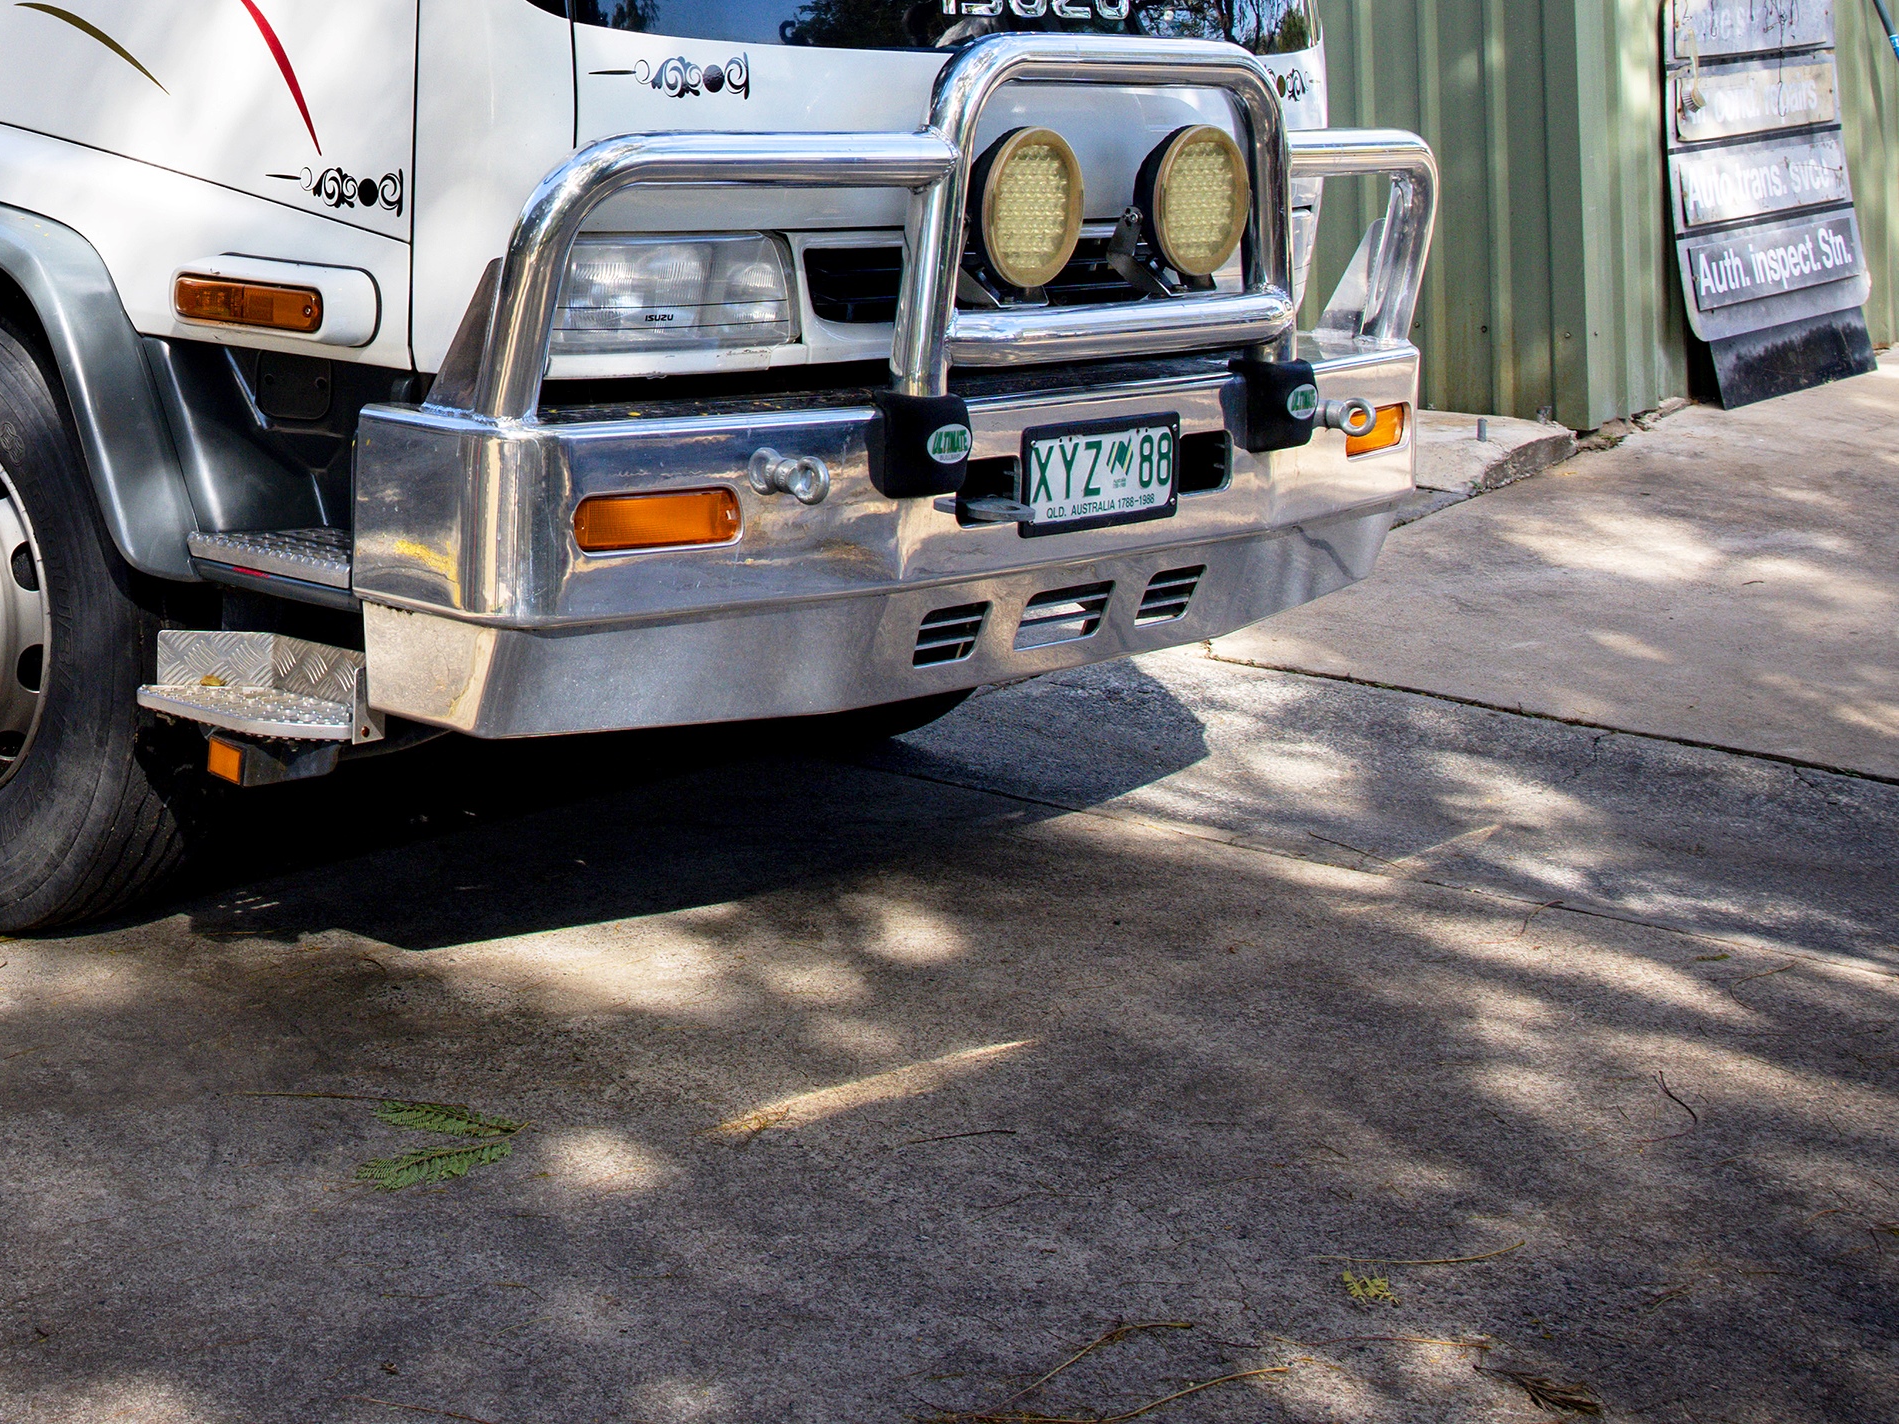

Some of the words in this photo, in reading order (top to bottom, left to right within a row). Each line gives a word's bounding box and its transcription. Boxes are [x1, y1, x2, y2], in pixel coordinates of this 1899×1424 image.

[1764, 78, 1818, 125] repairs
[1688, 166, 1732, 210] Auto
[1735, 162, 1787, 202] trans.
[1699, 248, 1750, 296] Auth.
[1749, 234, 1821, 289] inspect.
[1817, 227, 1852, 269] Stn.
[645, 314, 674, 322] ISUZU
[1031, 440, 1102, 504] XYZ
[1139, 432, 1173, 489] 88
[1046, 506, 1067, 519] QLD.
[1071, 499, 1115, 516] AUSTRALIA
[1117, 493, 1155, 508] 1788-1988
